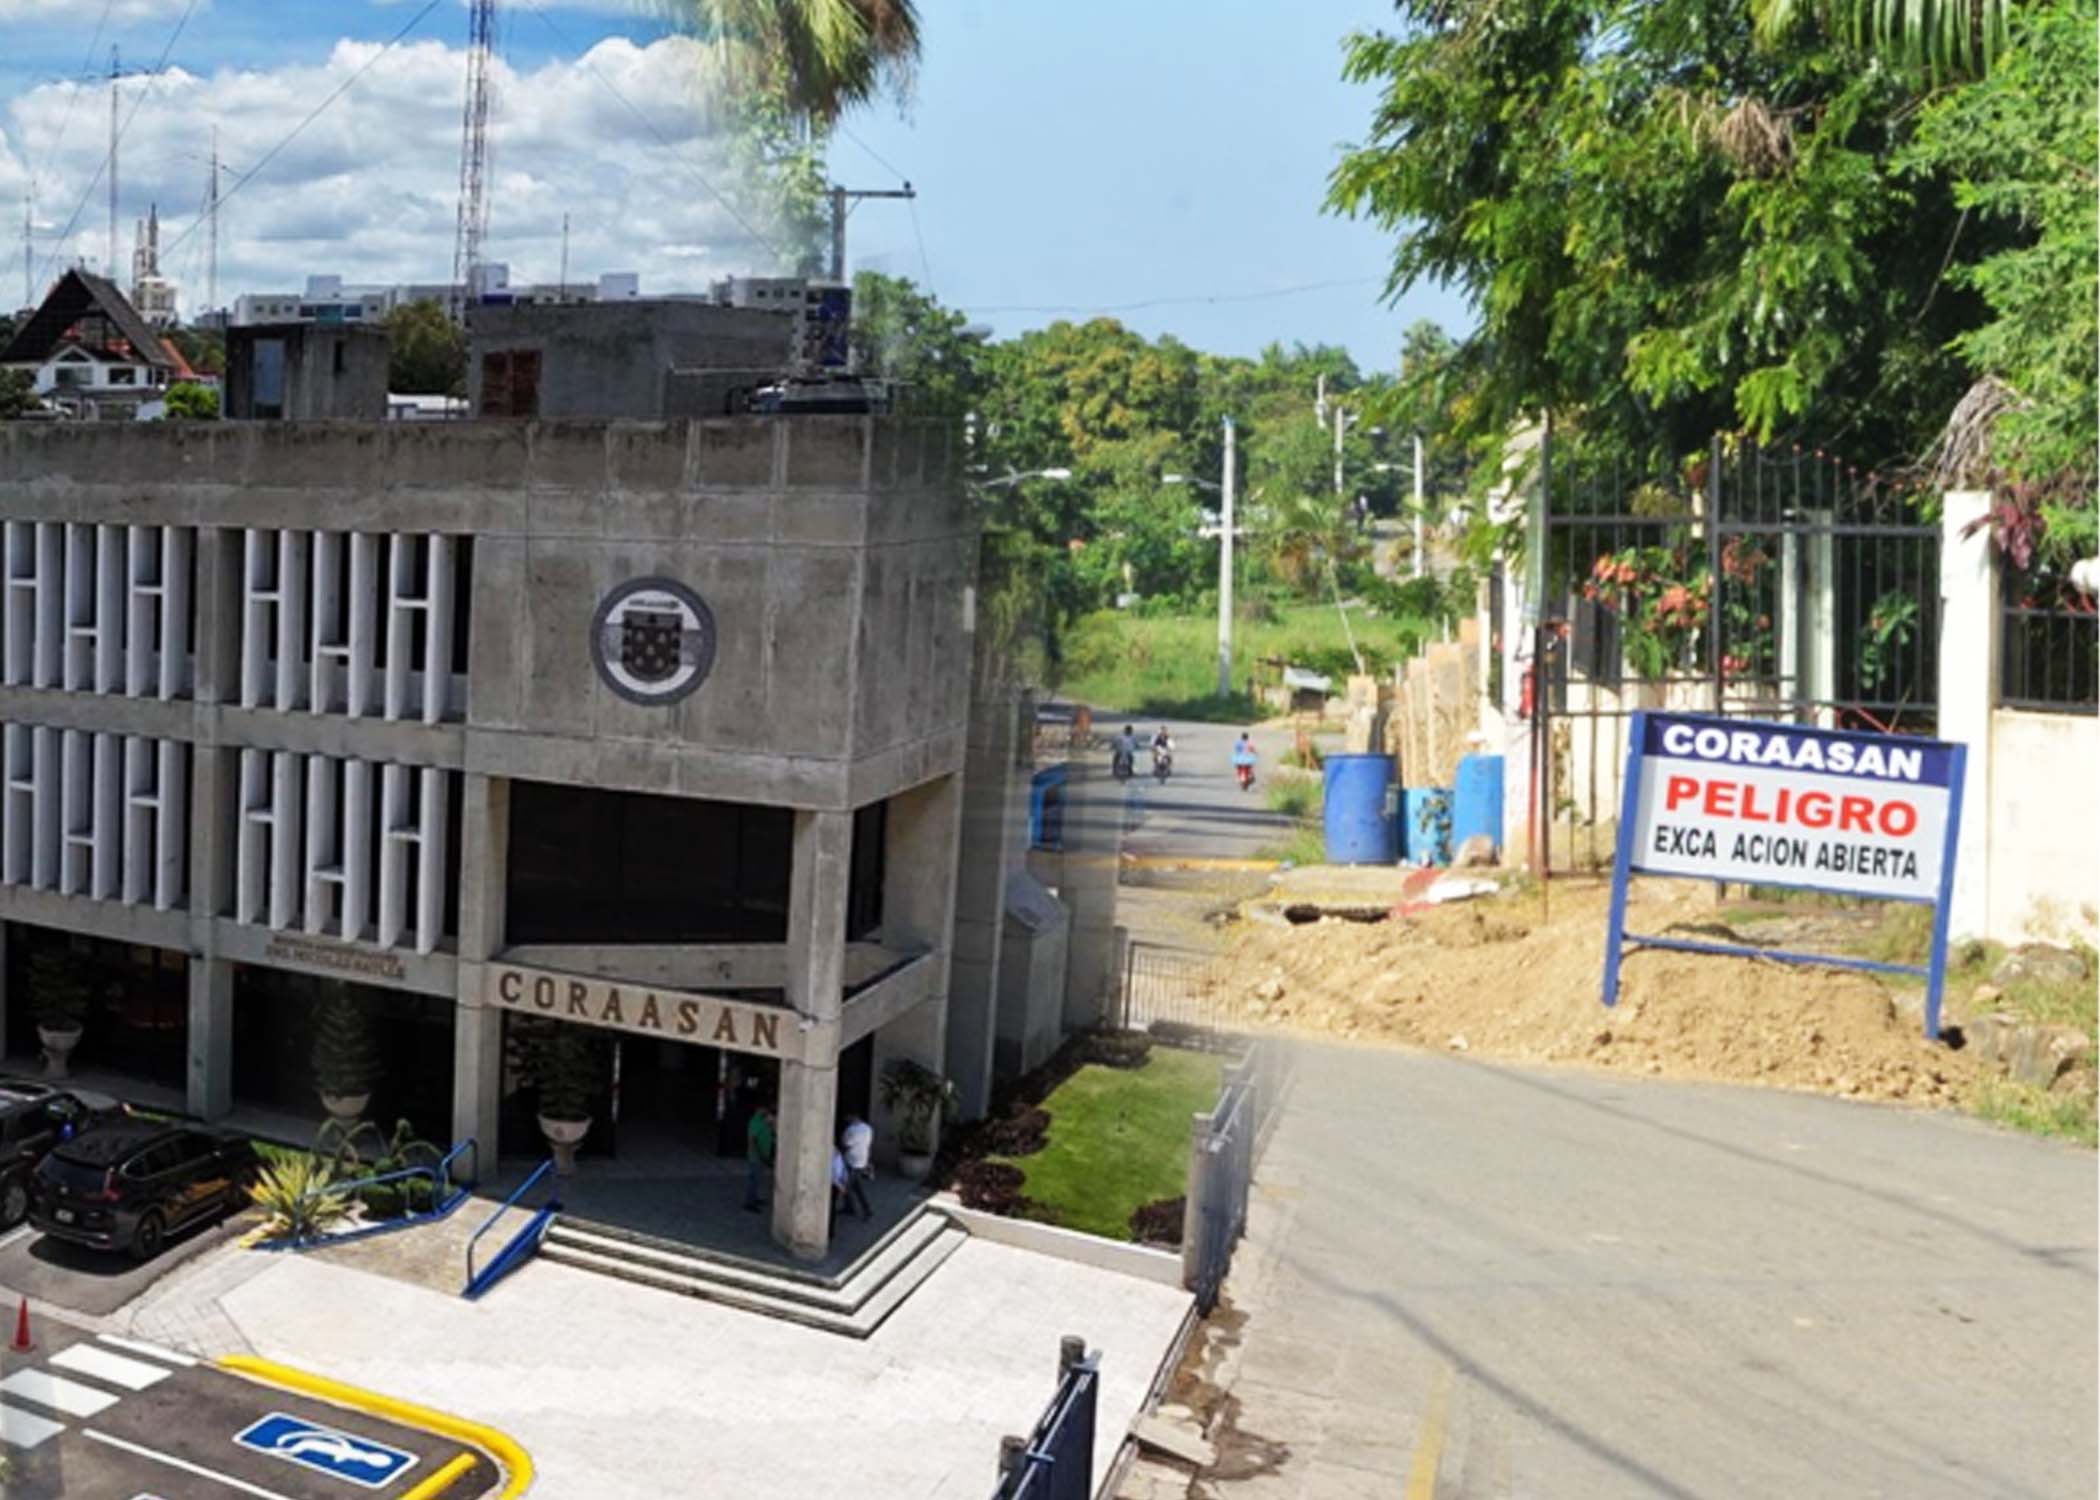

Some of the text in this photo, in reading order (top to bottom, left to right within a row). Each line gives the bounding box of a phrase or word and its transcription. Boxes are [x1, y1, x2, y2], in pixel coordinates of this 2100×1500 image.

[1663, 724, 1922, 779] CORAASAN
[1666, 775, 1917, 837] PELIGRO
[1814, 842, 1918, 879] ABIERTA
[500, 971, 780, 1049] CORAASAN
